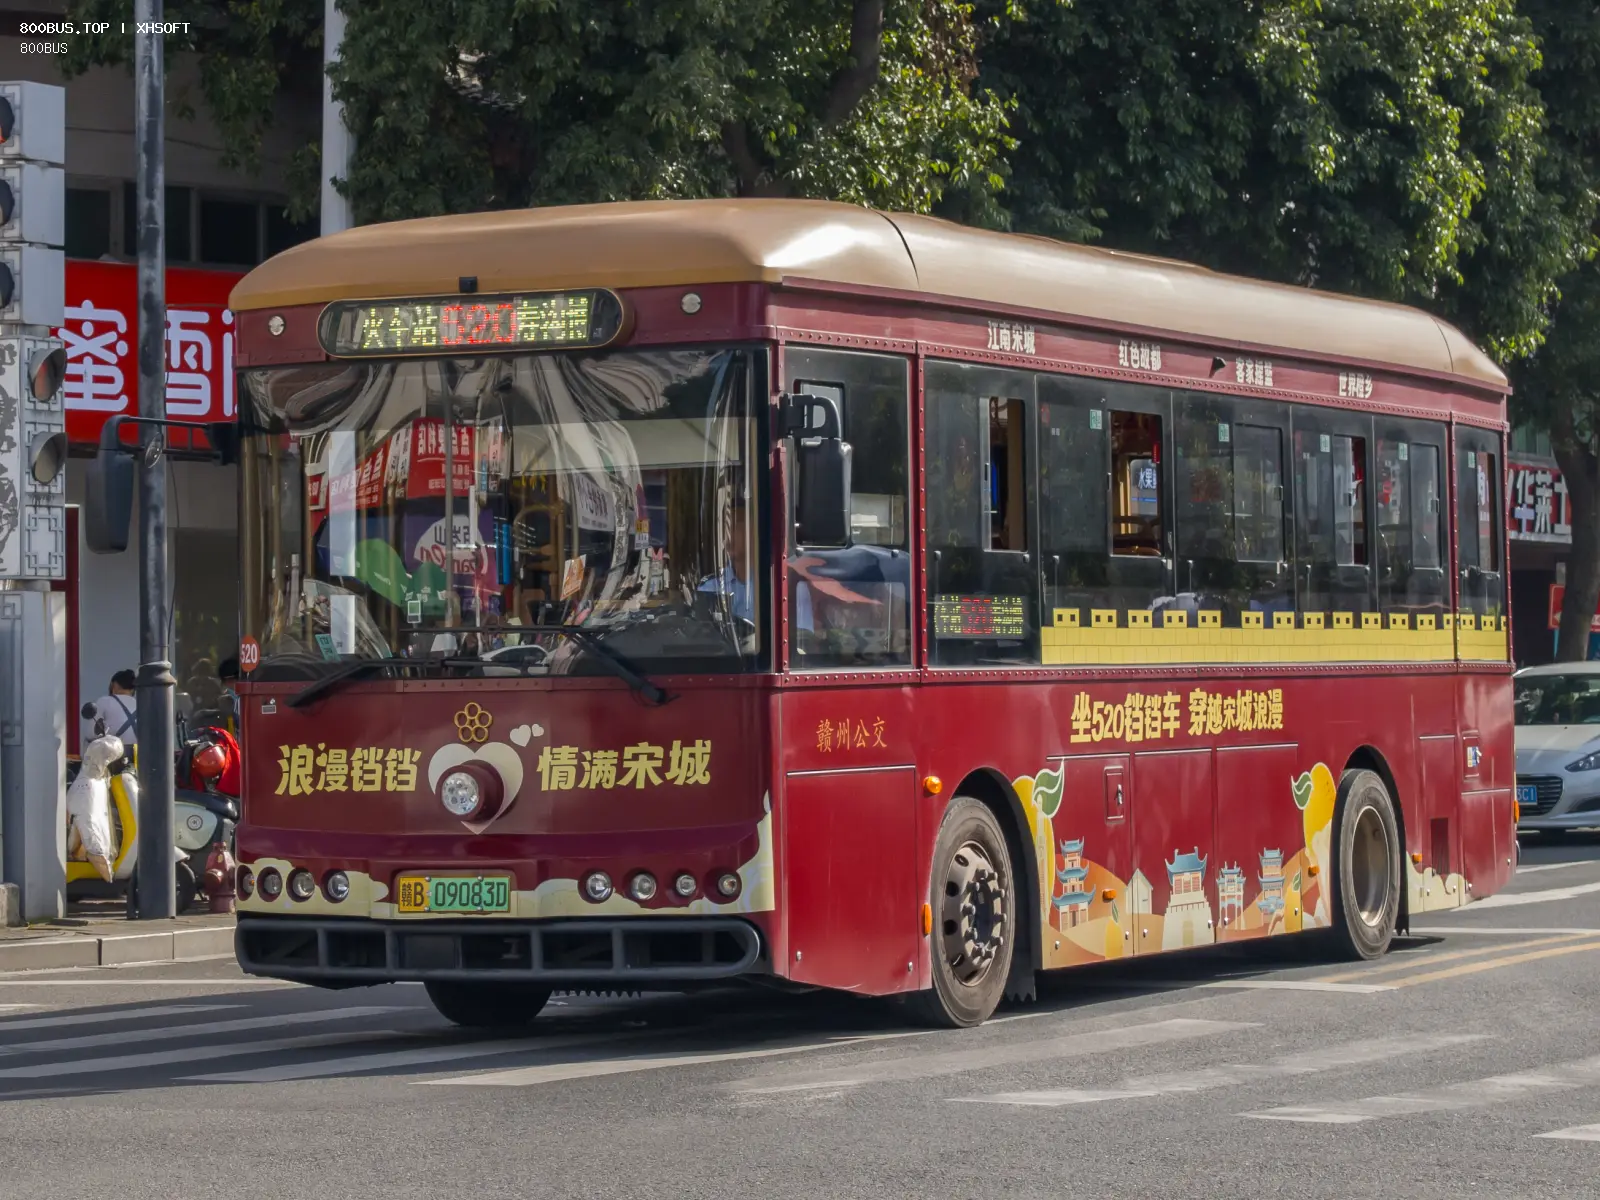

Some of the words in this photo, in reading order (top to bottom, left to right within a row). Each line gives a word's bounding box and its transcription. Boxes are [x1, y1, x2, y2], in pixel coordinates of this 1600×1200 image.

[441, 303, 516, 345] 520
[987, 320, 1036, 355] 江南宋城
[51, 299, 236, 417] 蜜雪
[1118, 339, 1162, 371] 红色故都
[239, 643, 258, 665] 520
[815, 716, 888, 753] 赣州公交
[1070, 691, 1181, 744] 坐520铛铛车
[1188, 687, 1284, 737] 穿越宋城浪漫
[274, 742, 422, 796] 浪漫铛铛
[536, 739, 712, 792] 情满宋城
